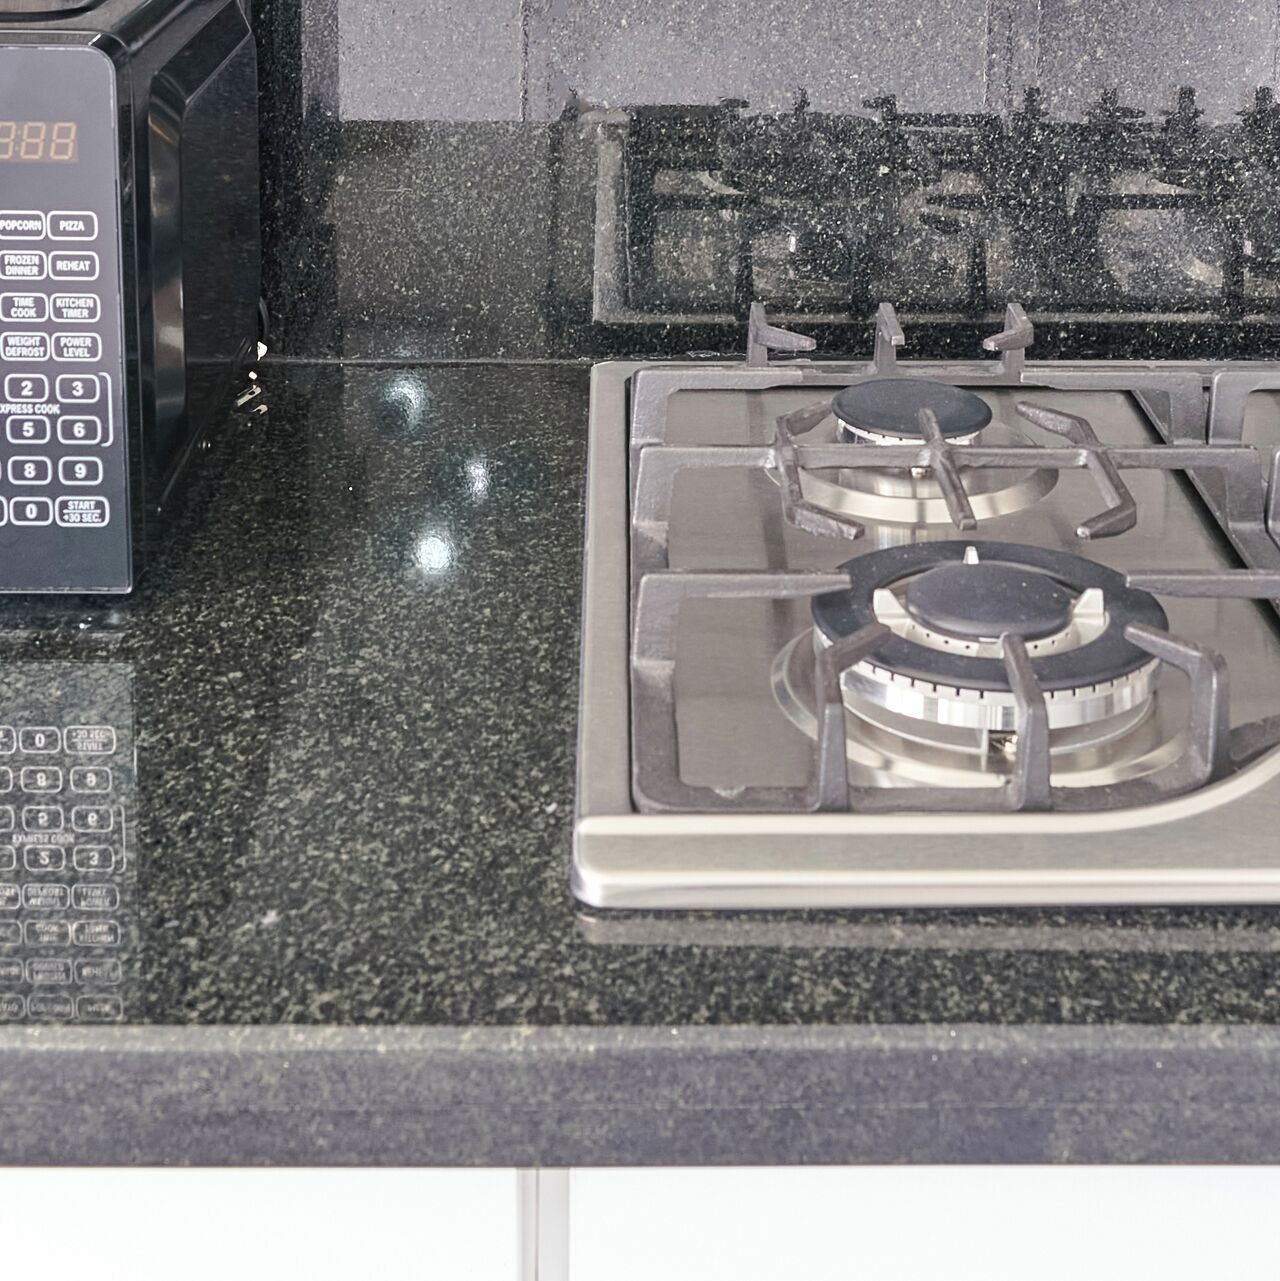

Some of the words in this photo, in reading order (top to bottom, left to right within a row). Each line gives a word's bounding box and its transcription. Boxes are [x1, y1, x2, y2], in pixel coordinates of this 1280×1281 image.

[0, 220, 41, 231] POPCORN
[60, 221, 84, 231] PIZZA
[4, 255, 39, 265] FROZEN
[6, 265, 38, 275] DINNER
[57, 261, 90, 271] REHEAT
[12, 297, 35, 307] TIME
[56, 298, 93, 308] KITCHEN
[11, 308, 36, 317] COOK
[61, 308, 88, 318] TIMER
[7, 337, 40, 346] WEIGHT
[60, 337, 91, 347] POWER
[5, 347, 45, 357] DEFROST
[63, 348, 90, 357] LEVEL
[21, 381, 33, 396] 2
[72, 381, 83, 396] 3
[35, 404, 60, 414] COOK
[22, 422, 34, 437] 5
[73, 422, 85, 437] 6
[24, 463, 35, 478] 8
[75, 463, 87, 478] 9
[68, 501, 95, 509] START
[26, 503, 37, 519] 0
